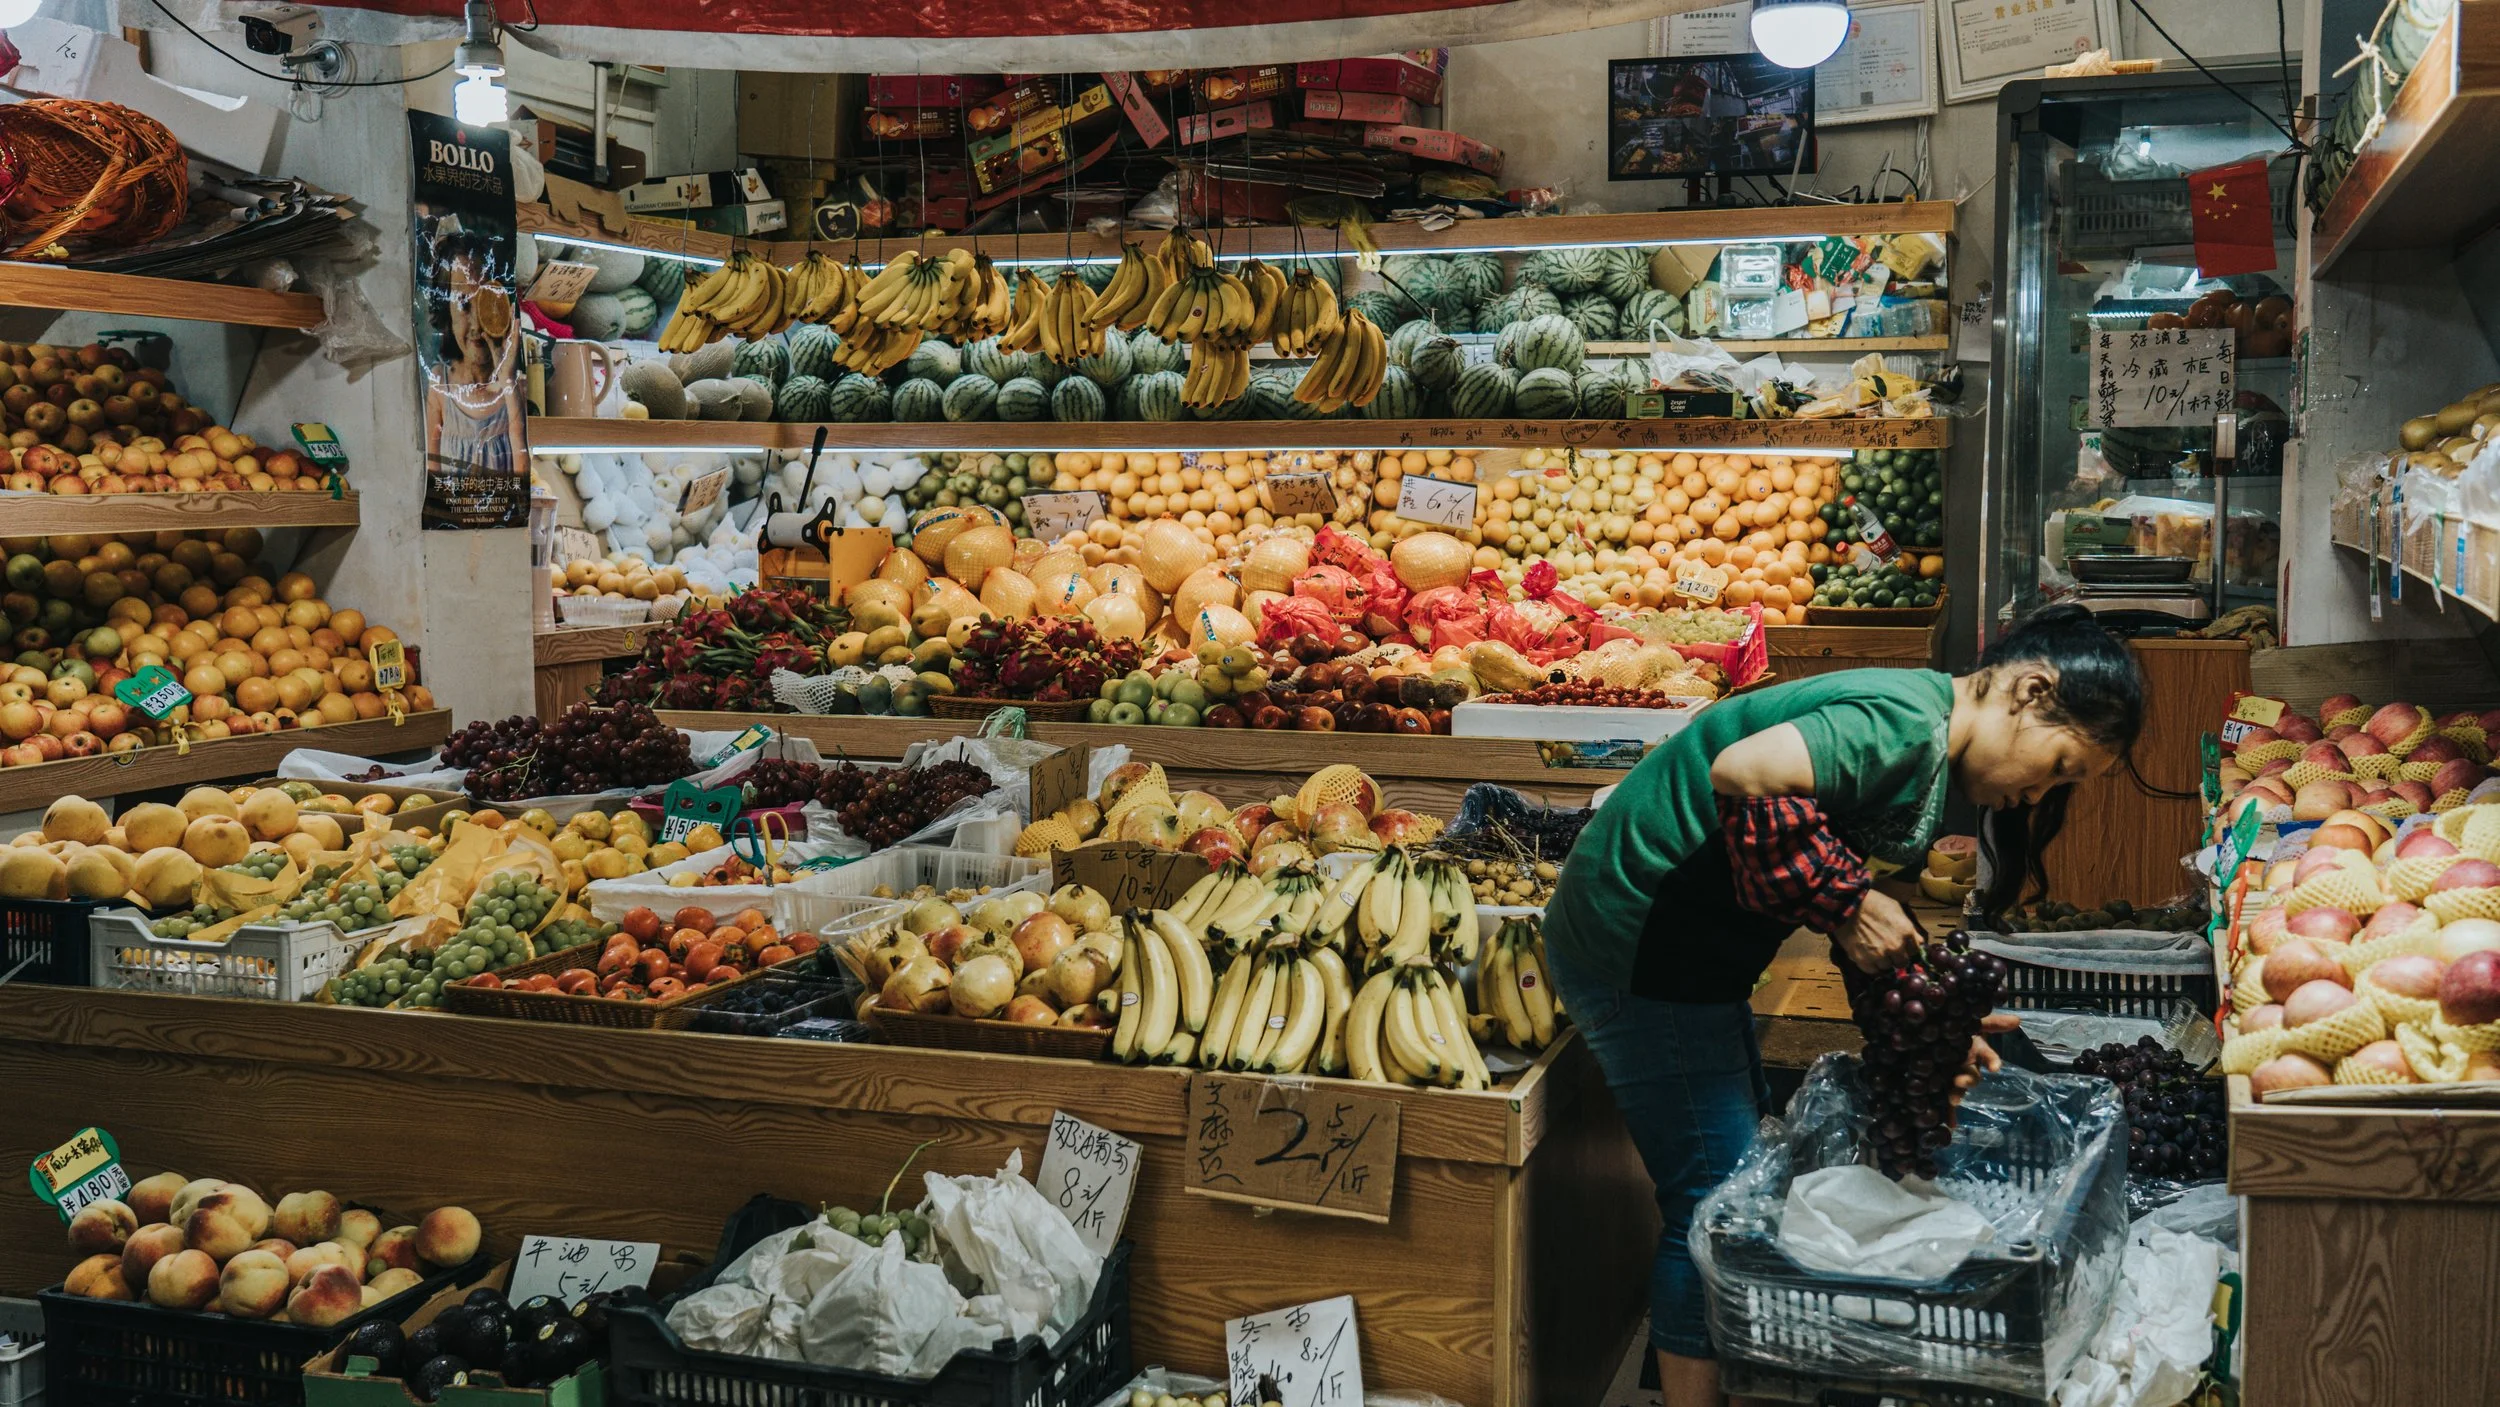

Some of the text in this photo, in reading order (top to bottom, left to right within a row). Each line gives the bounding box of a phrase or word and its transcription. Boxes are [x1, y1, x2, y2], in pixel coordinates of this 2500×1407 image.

[430, 140, 495, 174] BOLLO
[423, 163, 503, 196] 水果界的艺术品
[1055, 1115, 1134, 1175] 奶油葡萄
[526, 1239, 636, 1272] 牛油果
